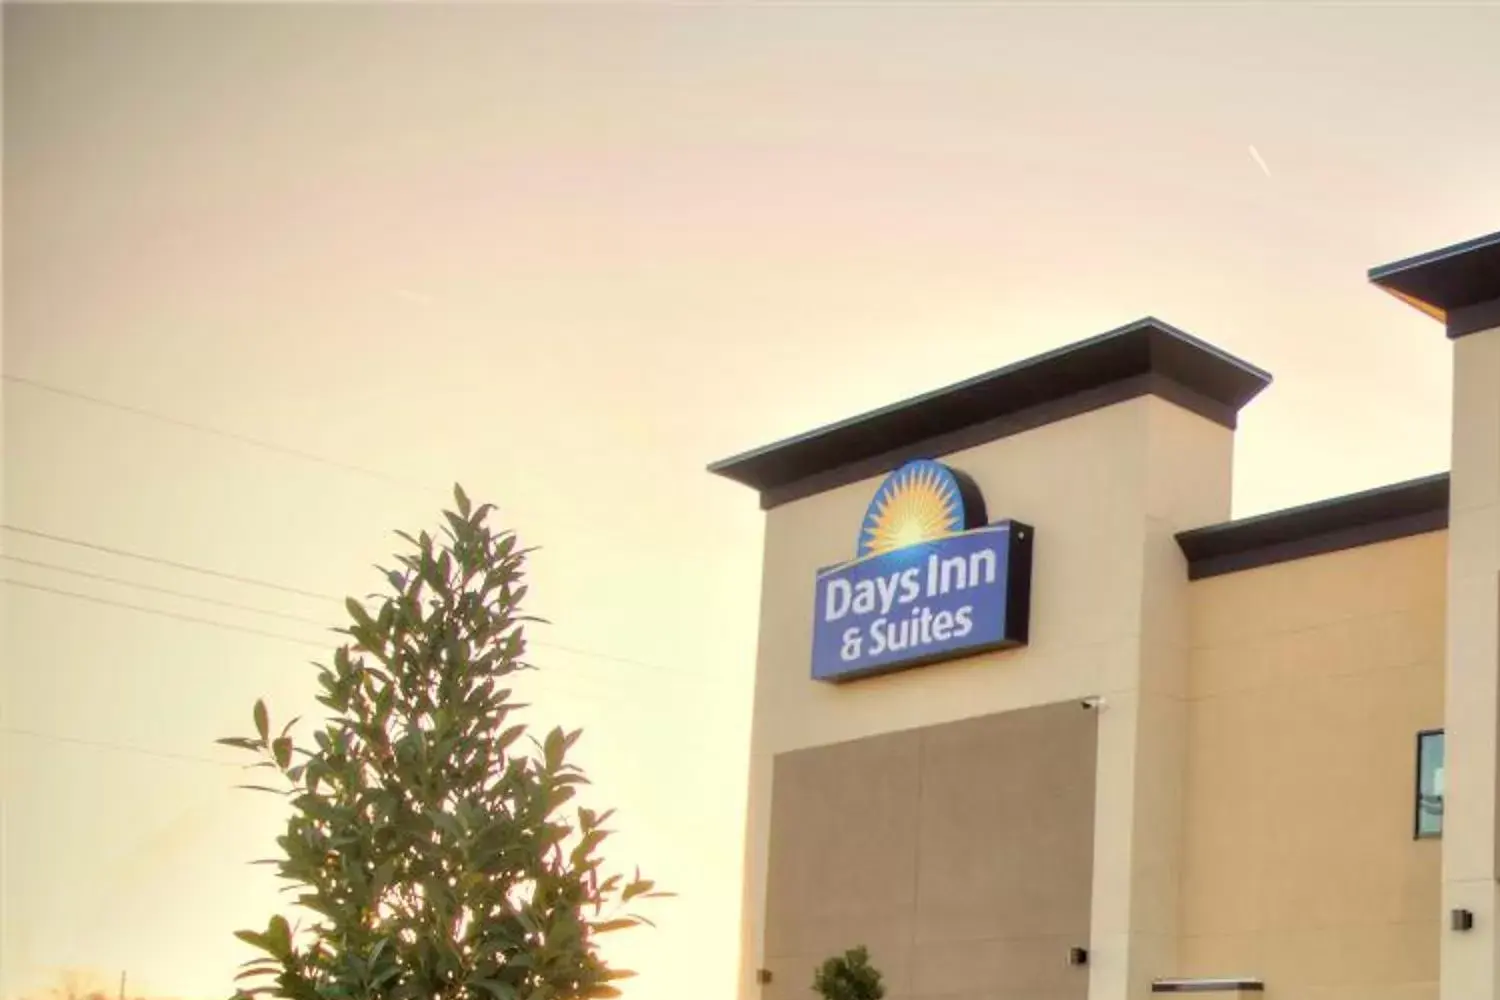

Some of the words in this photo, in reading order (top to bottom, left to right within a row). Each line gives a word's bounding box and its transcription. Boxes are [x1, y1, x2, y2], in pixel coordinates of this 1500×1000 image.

[825, 568, 920, 622] Days
[927, 547, 996, 598] Inn
[840, 627, 863, 661] &
[868, 604, 974, 656] Suites
